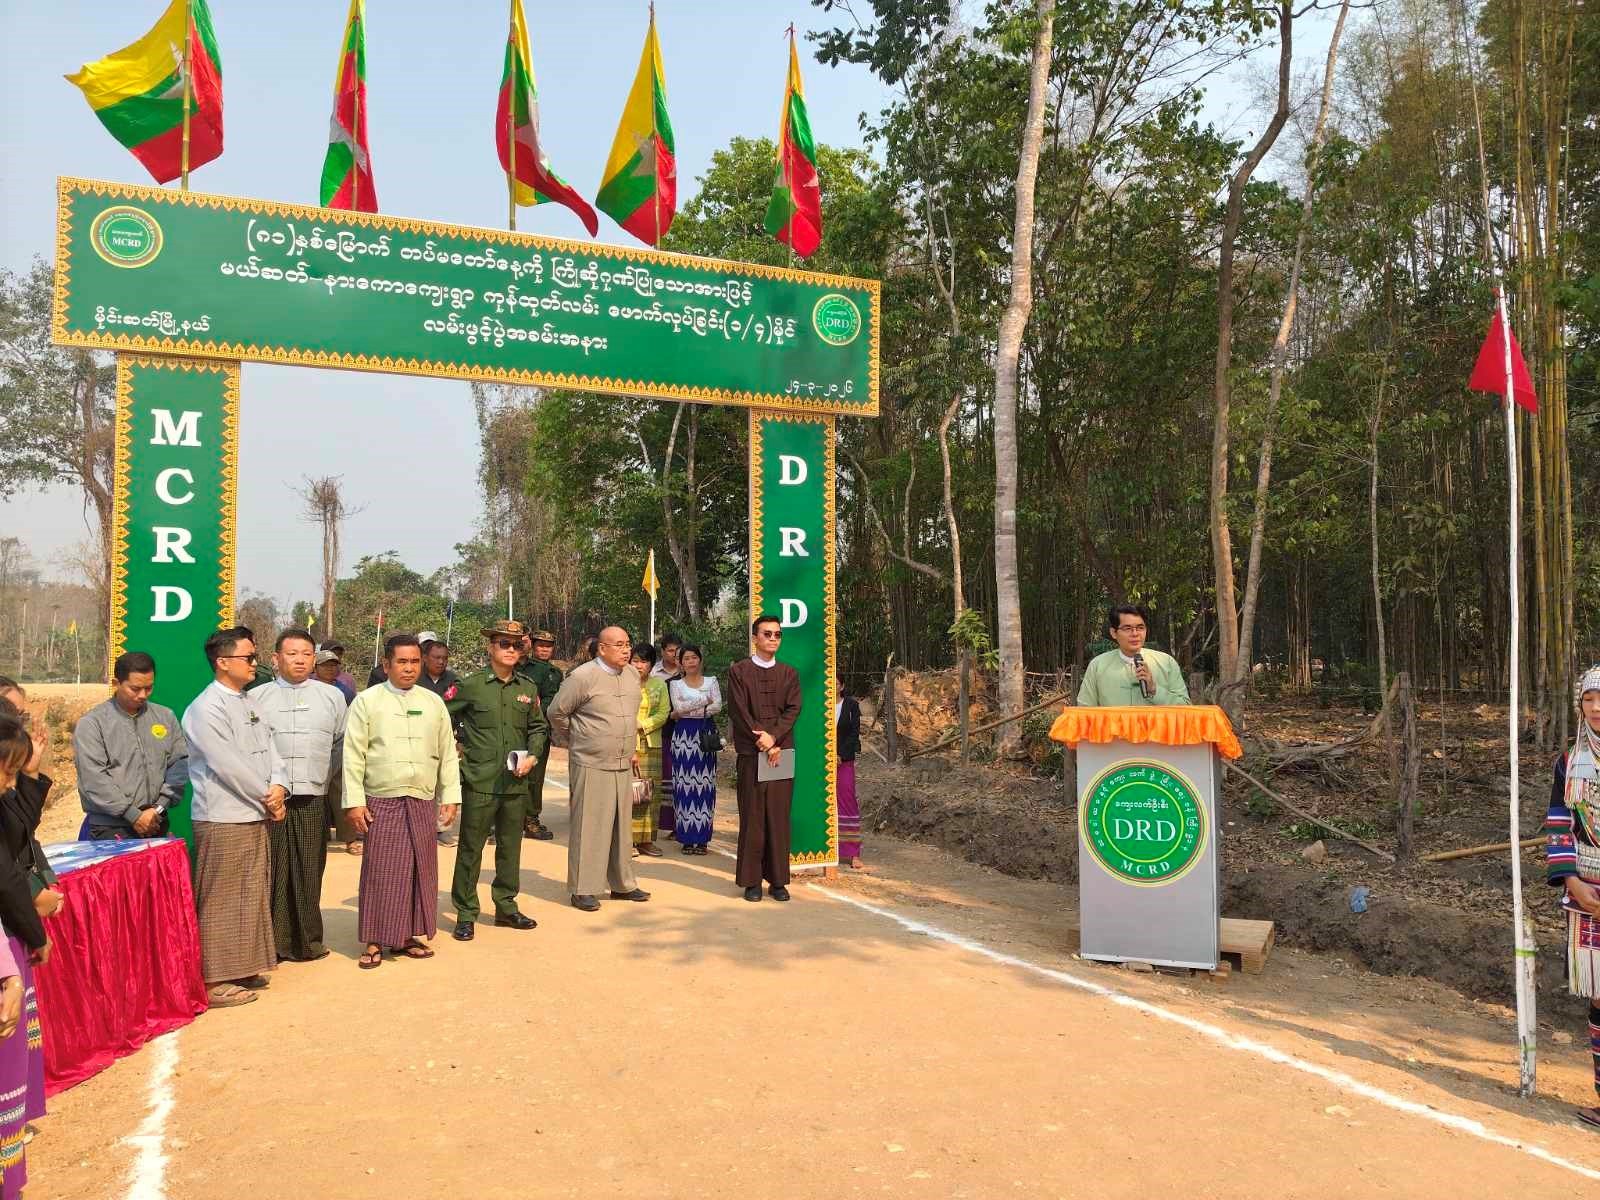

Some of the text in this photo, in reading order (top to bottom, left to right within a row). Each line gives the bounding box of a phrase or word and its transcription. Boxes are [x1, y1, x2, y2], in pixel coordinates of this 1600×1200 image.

[112, 237, 141, 248] MCRD
[400, 241, 544, 284] တပ်မတော်နေ့ကို
[483, 284, 600, 318] ကုန်ထုတ်လမ်း
[826, 317, 849, 329] DRD
[150, 408, 202, 622] MCRD
[779, 455, 809, 628] DRD
[1112, 818, 1176, 842] DRD
[1121, 859, 1171, 875] MCRD
